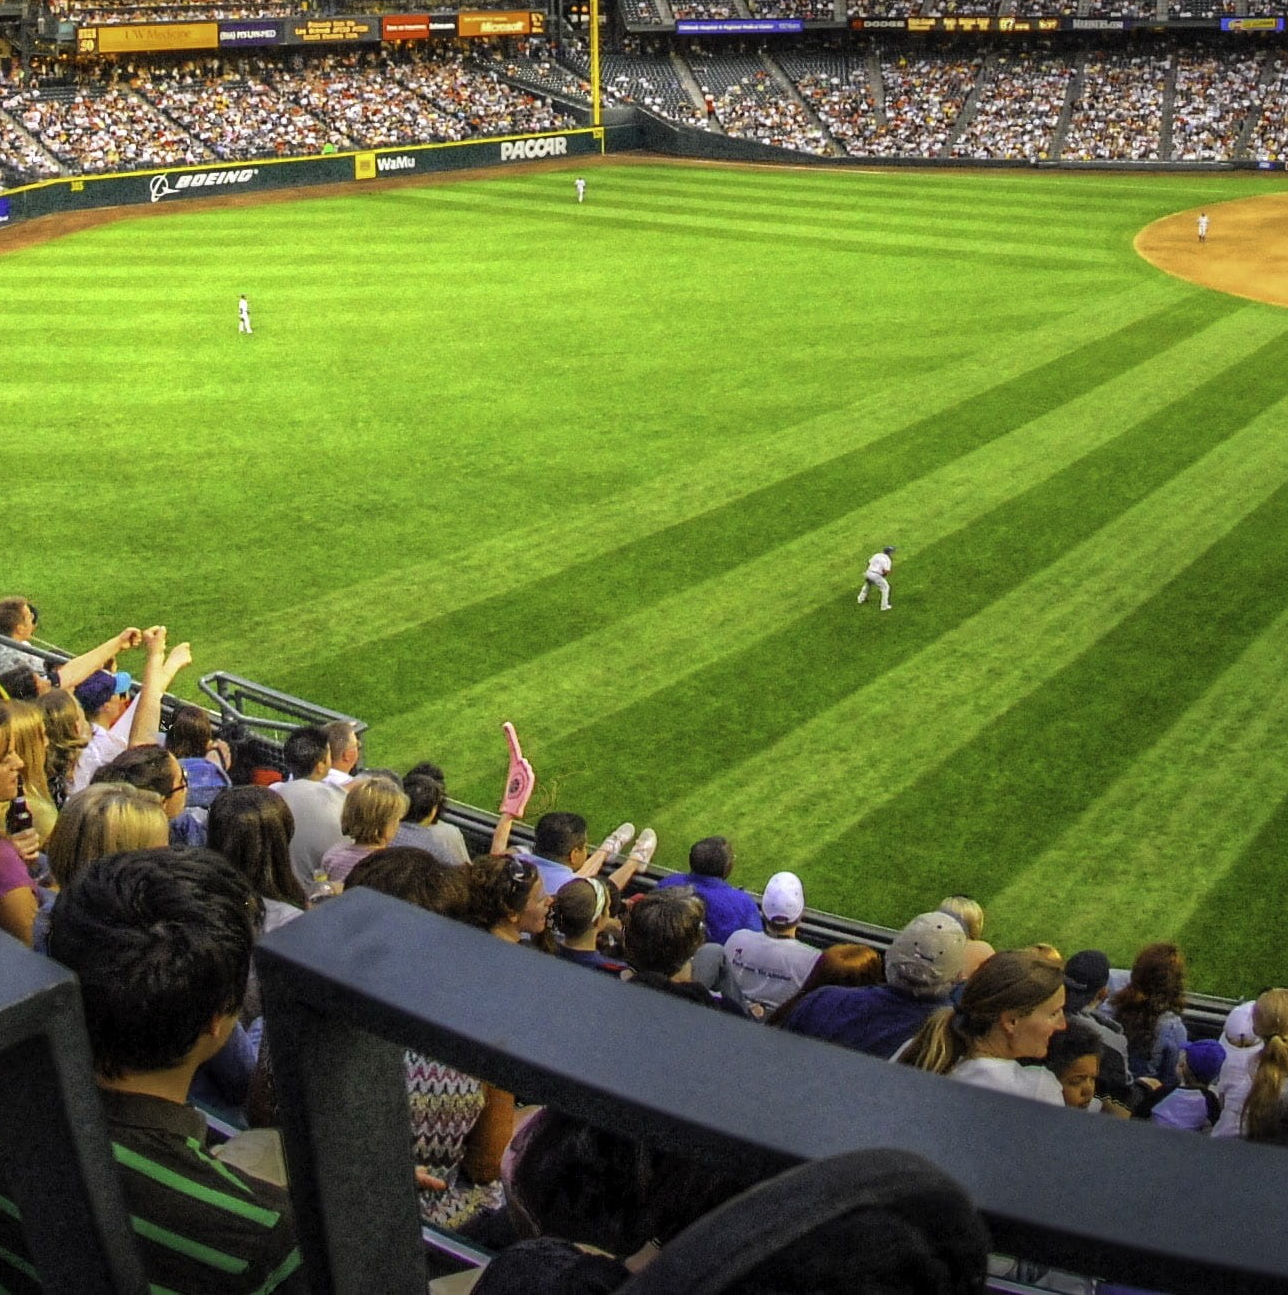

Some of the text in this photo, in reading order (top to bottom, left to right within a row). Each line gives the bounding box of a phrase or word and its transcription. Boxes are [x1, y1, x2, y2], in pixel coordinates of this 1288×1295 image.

[863, 20, 905, 28] DODGE
[500, 136, 568, 161] PACCAR
[376, 156, 416, 171] WaMu
[174, 169, 255, 189] BOEING
